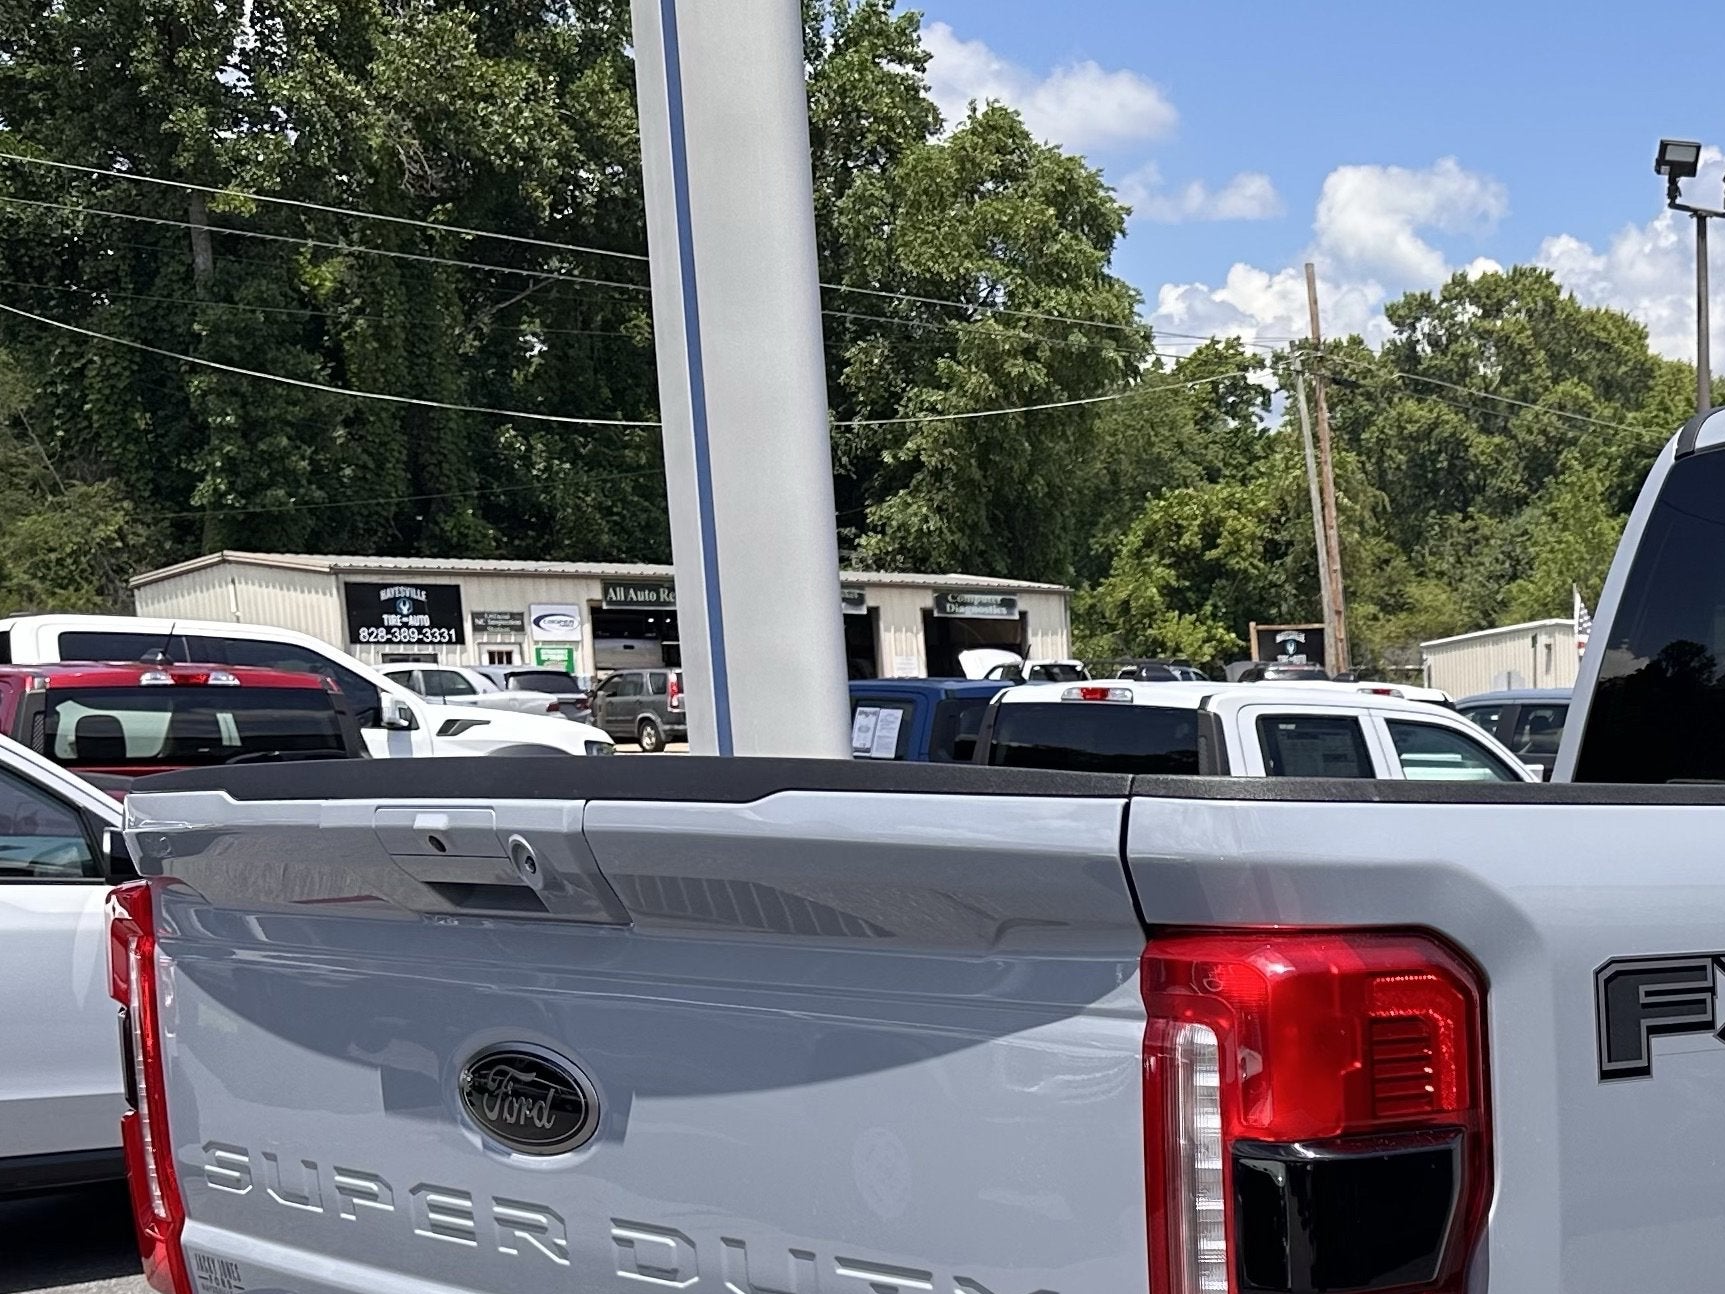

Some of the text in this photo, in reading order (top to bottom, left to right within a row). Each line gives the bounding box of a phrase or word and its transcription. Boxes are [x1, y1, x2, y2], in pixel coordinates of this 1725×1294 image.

[607, 587, 625, 601] All
[627, 587, 656, 601] Auto
[359, 627, 456, 642] 828-389-3331
[483, 1064, 556, 1129] Ford
[201, 1140, 570, 1267] SUPER
